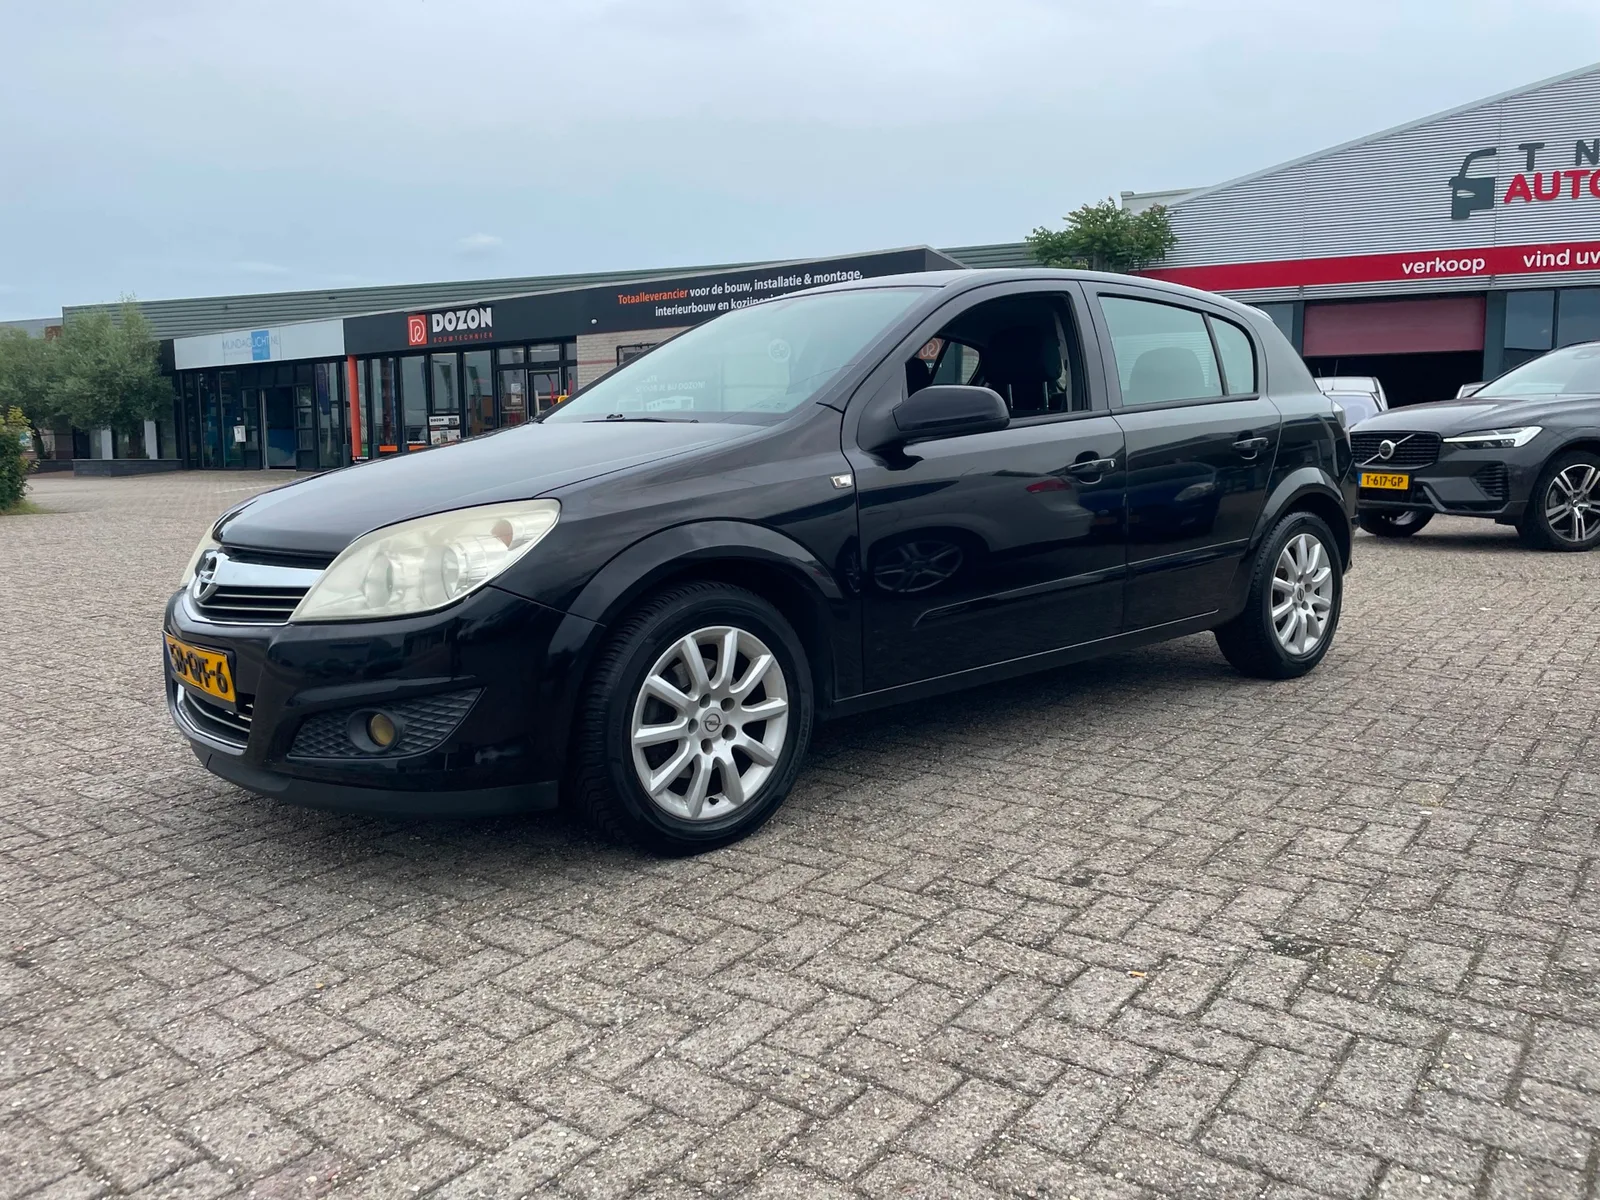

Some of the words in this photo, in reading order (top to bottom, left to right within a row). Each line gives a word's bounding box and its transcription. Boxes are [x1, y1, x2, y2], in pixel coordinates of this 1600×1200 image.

[1402, 257, 1486, 274] verkoop
[1523, 249, 1570, 267] vind
[618, 289, 688, 305] Totaalleverancier
[690, 286, 710, 298] voor
[711, 284, 722, 295] de
[724, 281, 752, 293] bouw,
[754, 274, 802, 290] installatie
[804, 273, 812, 284] &
[655, 299, 716, 317] interieurbouw
[717, 301, 730, 311] en
[432, 307, 493, 333] DOZON
[433, 332, 493, 343] BOUWTECHNIEK
[1365, 475, 1404, 487] T-617-GP
